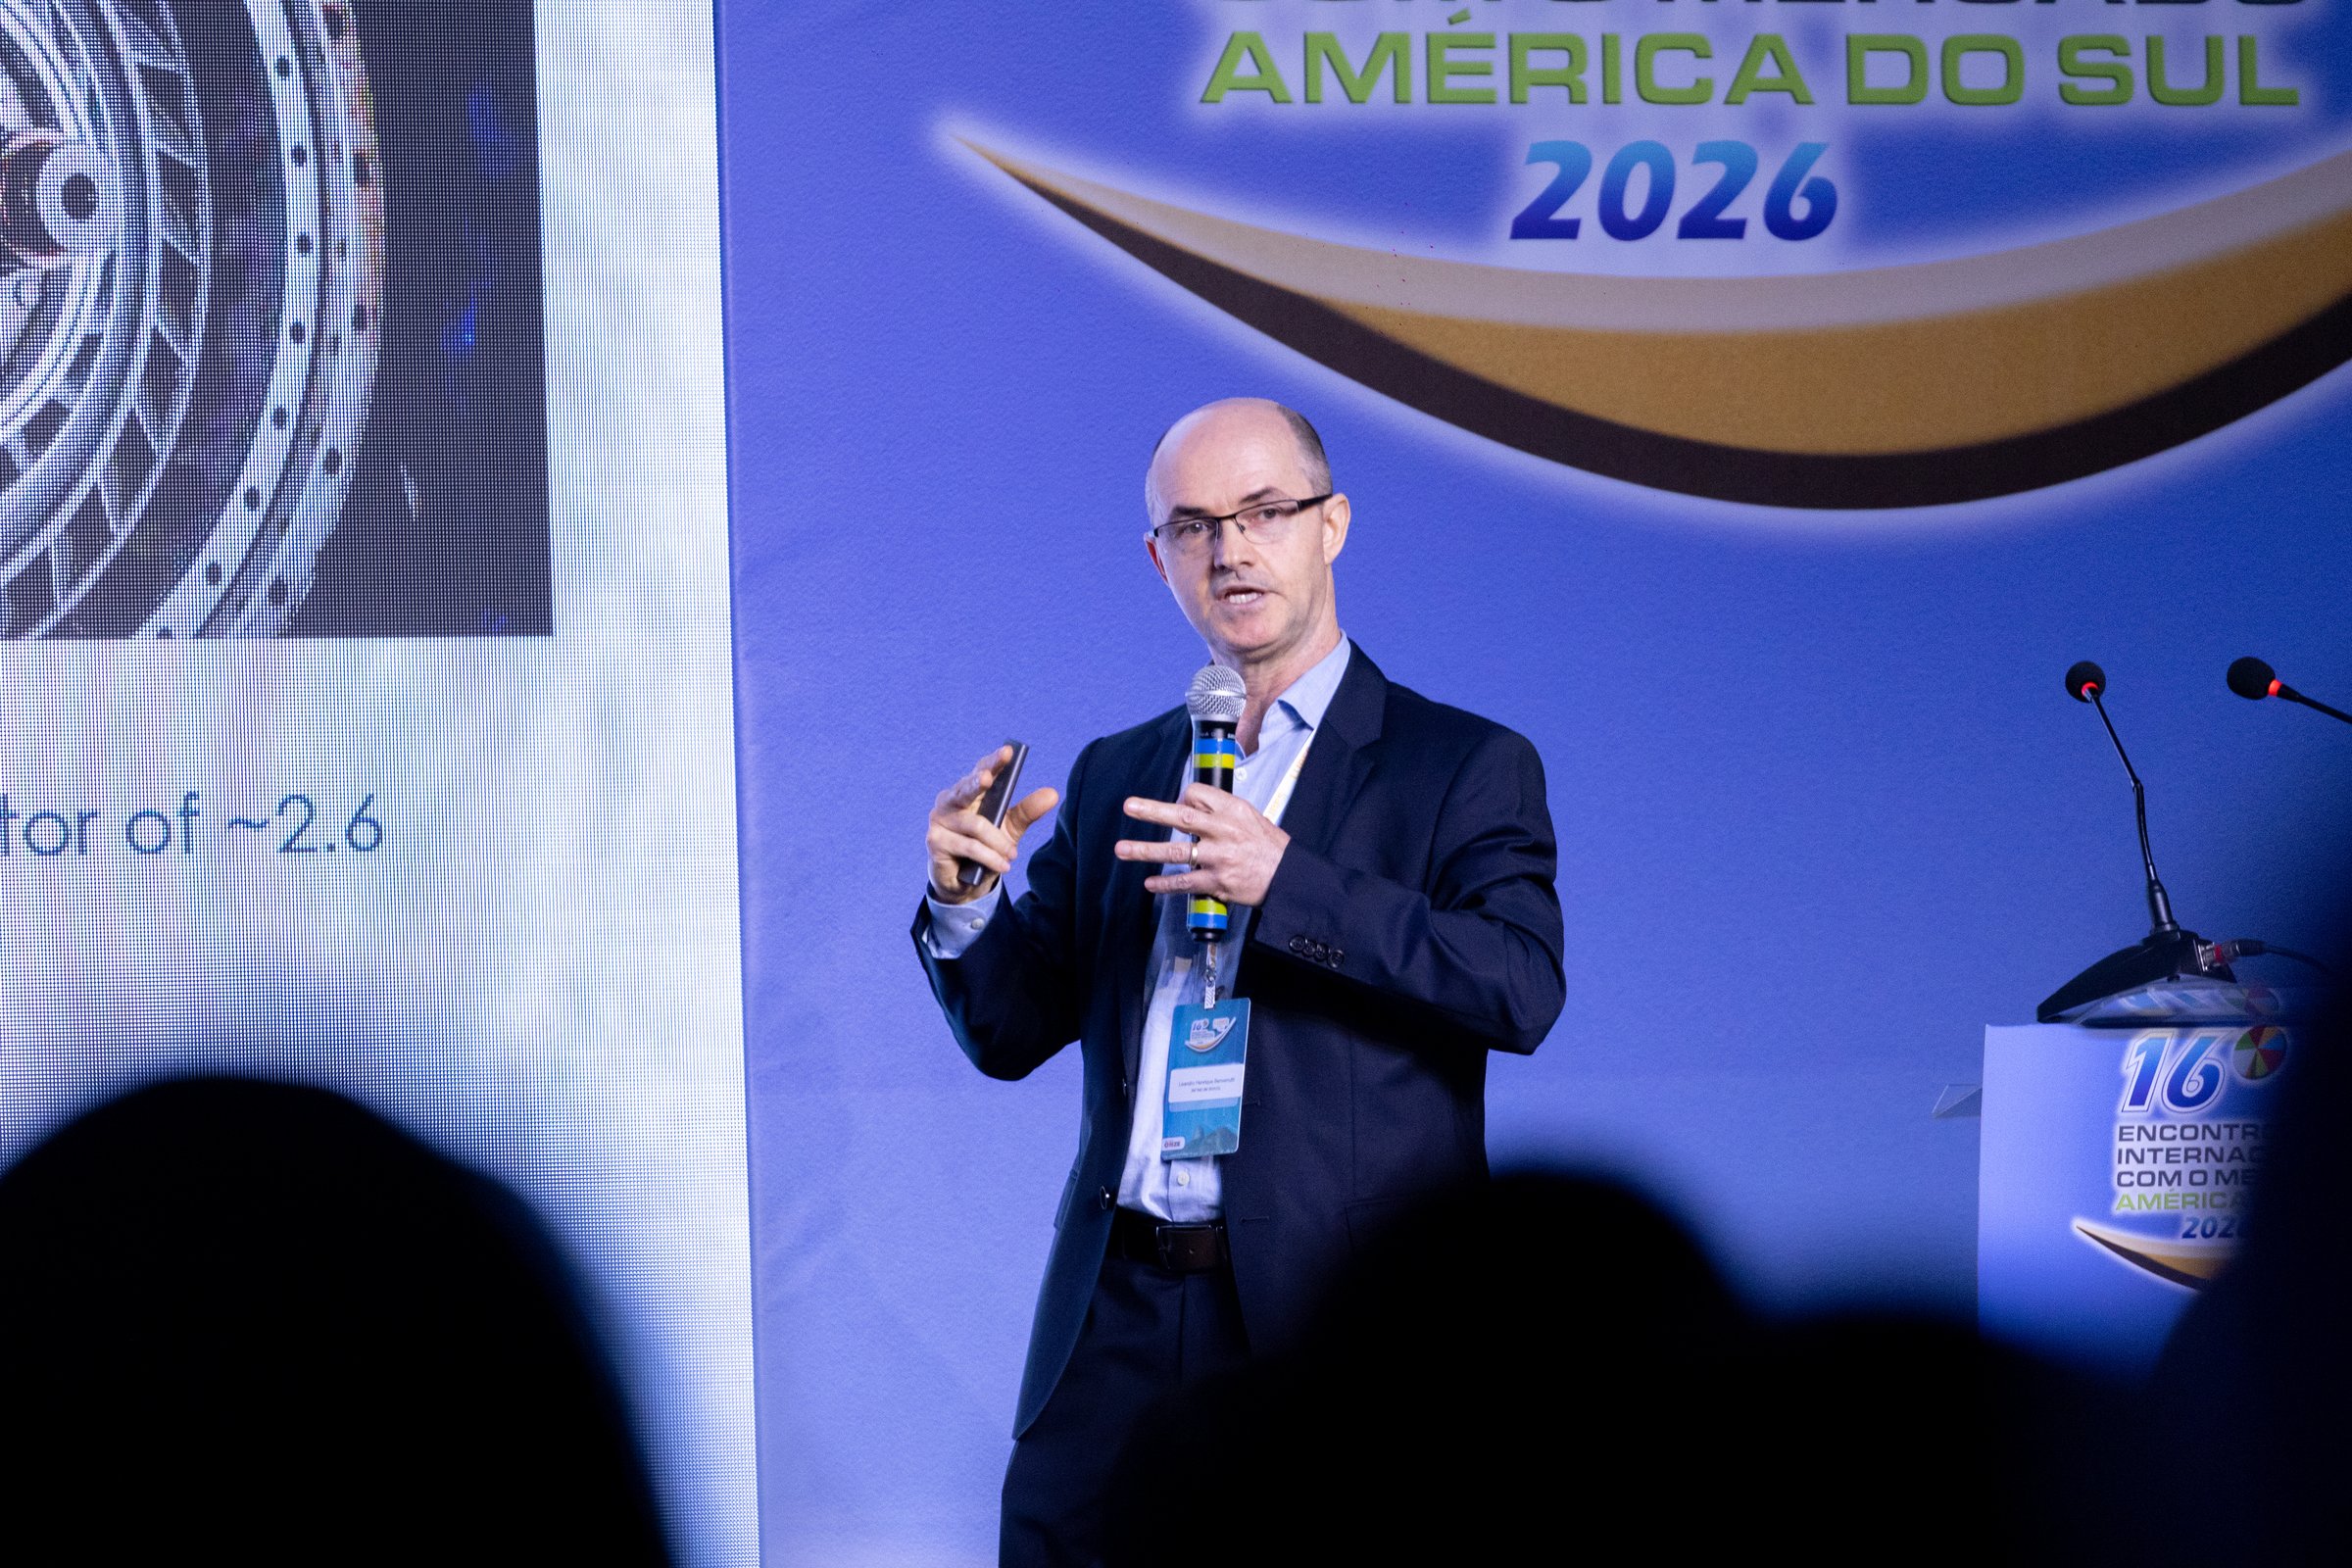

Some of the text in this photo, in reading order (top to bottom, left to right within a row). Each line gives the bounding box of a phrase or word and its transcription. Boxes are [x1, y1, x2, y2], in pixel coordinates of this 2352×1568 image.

[1200, 9, 2300, 107] AMÉRICA DO SUL
[1509, 139, 1838, 242] 2026
[0, 791, 383, 857] tor of ~2.6
[2122, 1029, 2226, 1113] 16
[2116, 1169, 2181, 1188] COM
[2188, 1169, 2208, 1187] O
[2117, 1147, 2264, 1164] INTERNAC
[2181, 1216, 2238, 1240] 202
